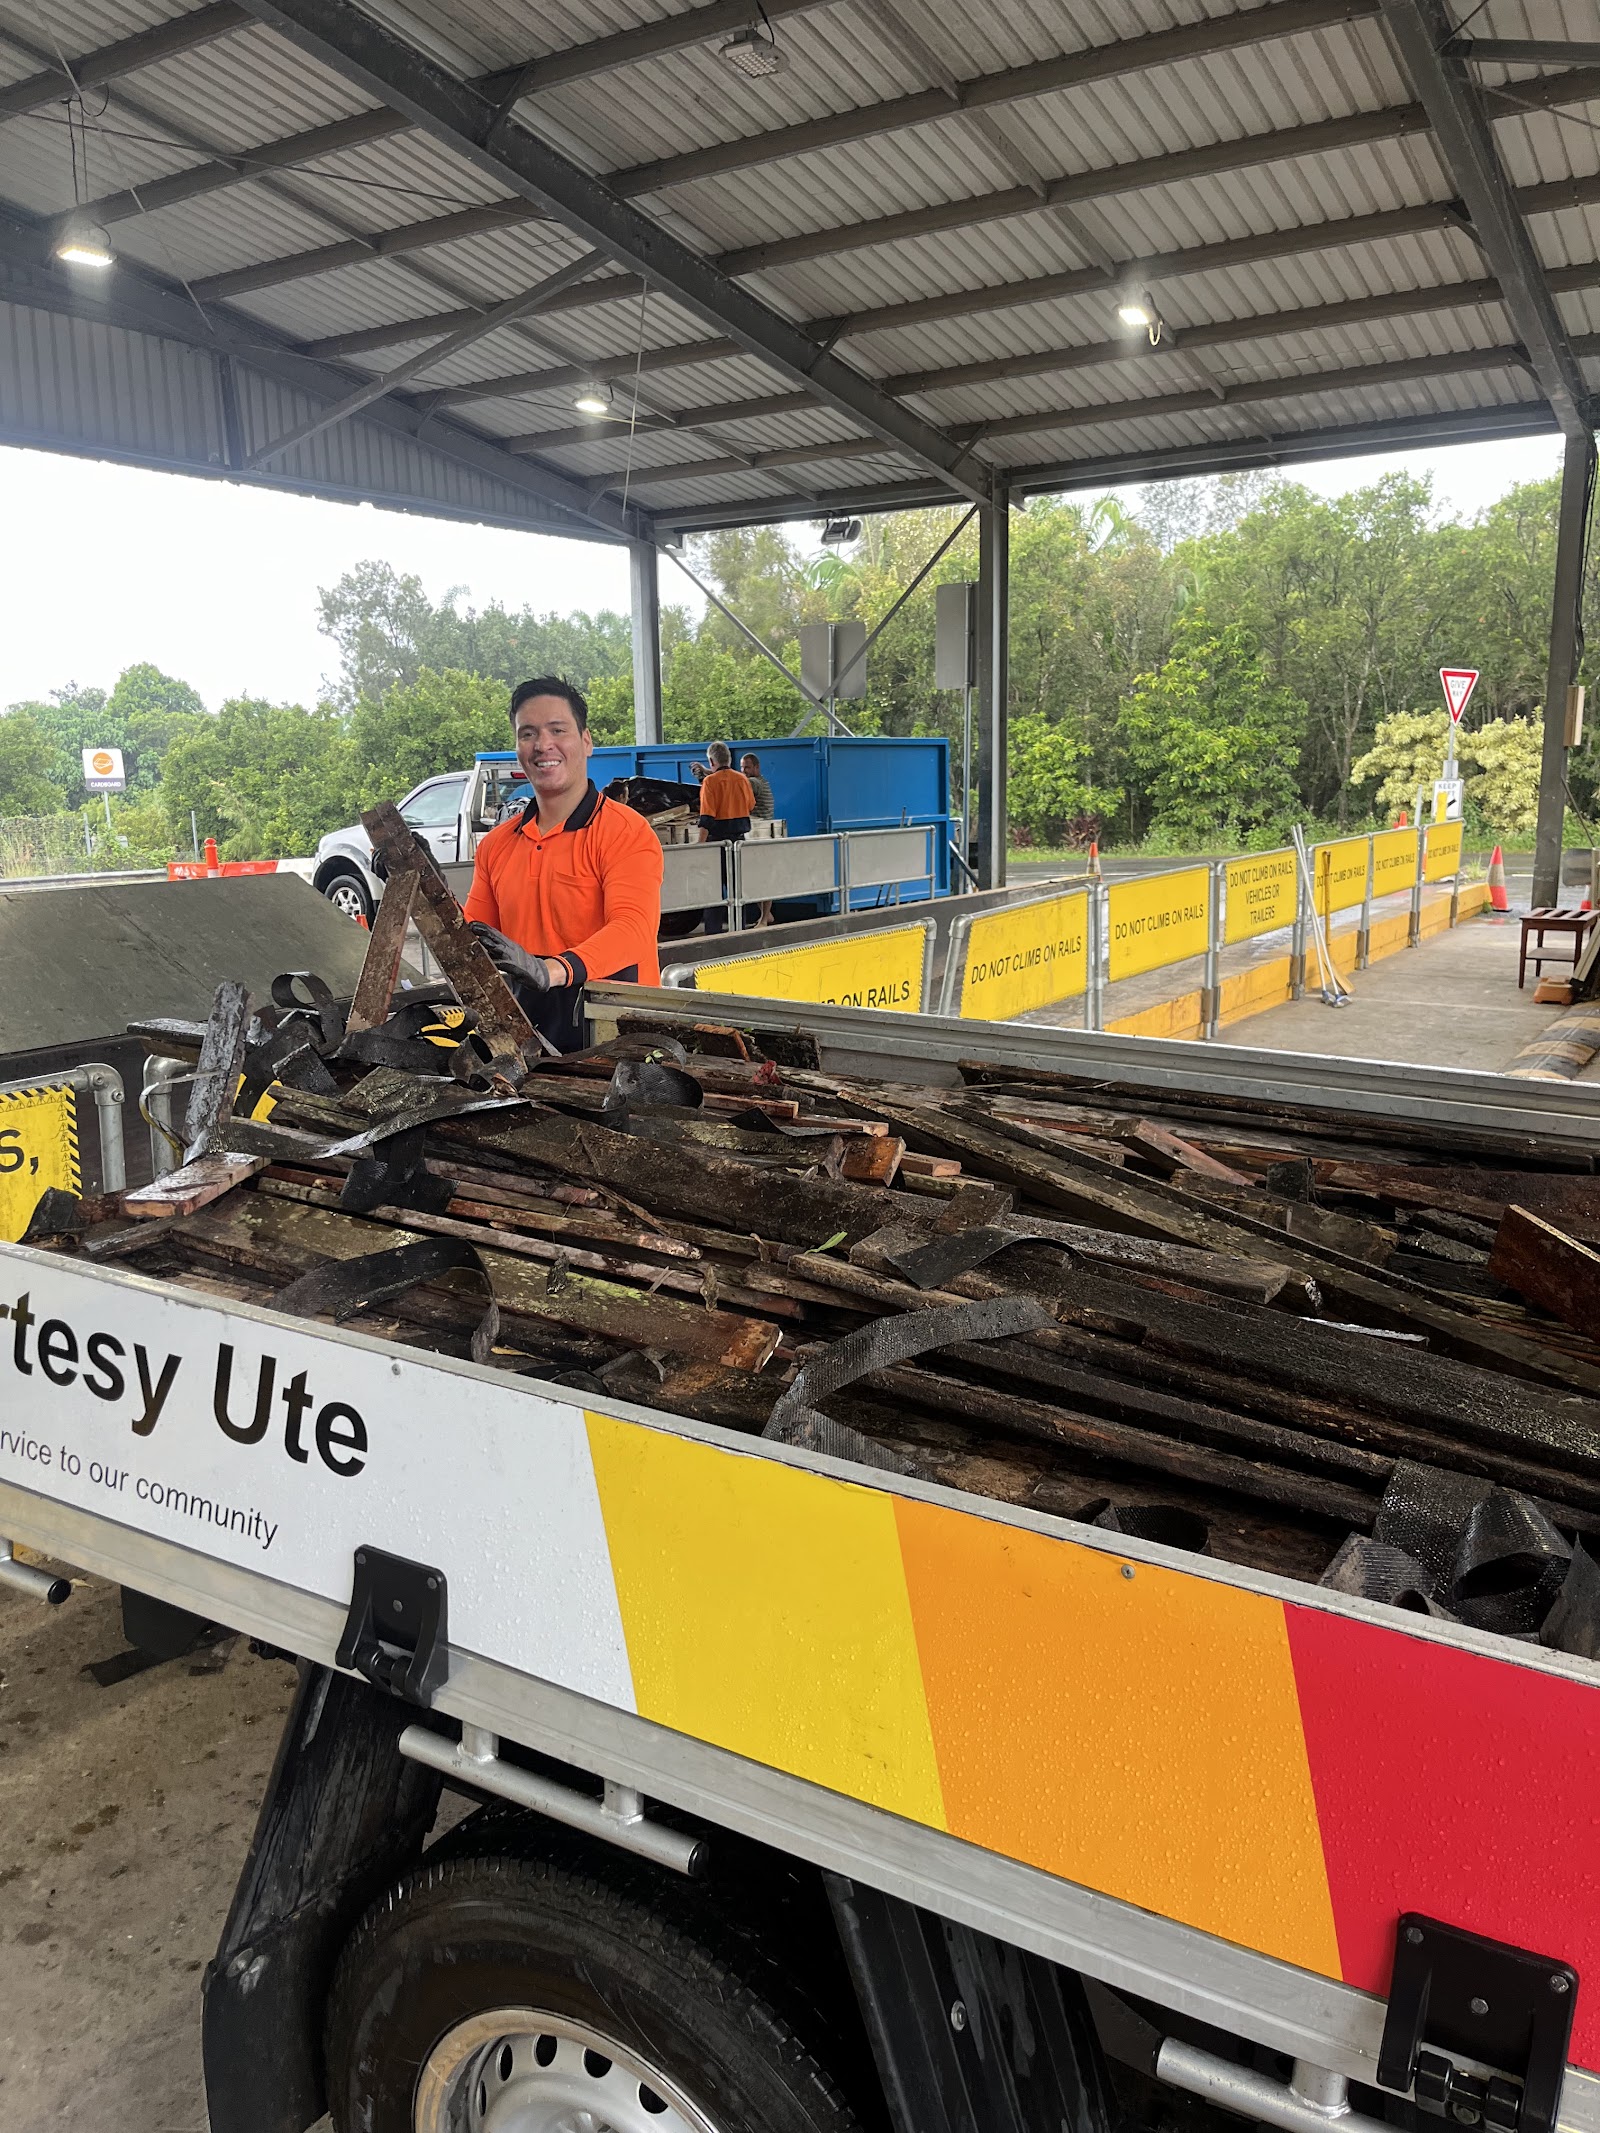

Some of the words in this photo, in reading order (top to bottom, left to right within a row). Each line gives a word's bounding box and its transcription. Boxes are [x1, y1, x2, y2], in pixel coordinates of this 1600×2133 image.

[1450, 680, 1466, 689] GIVE
[1230, 872, 1238, 887] DO
[1240, 869, 1251, 886] NOT
[1252, 866, 1268, 882] CLIMB
[1269, 864, 1277, 878] ON
[1278, 860, 1293, 877] RAILS,
[1246, 886, 1271, 904] VEHICLES
[1272, 884, 1280, 898] OR
[1116, 923, 1127, 940] DO
[1129, 918, 1146, 936] NOT
[1147, 912, 1170, 931] CLIMB
[1172, 909, 1182, 924] ON
[1184, 904, 1204, 922] RAILS
[1250, 905, 1275, 925] TRAILERS
[972, 964, 987, 984] DO
[989, 956, 1011, 979] NOT
[1012, 948, 1041, 972] CLIMB
[1043, 943, 1057, 962] ON
[1058, 936, 1081, 957] RAILS
[868, 980, 910, 1007] RAILS
[214, 1342, 368, 1478] Ute
[60, 1446, 81, 1475] to
[90, 1462, 129, 1491] our
[136, 1477, 278, 1550] community
